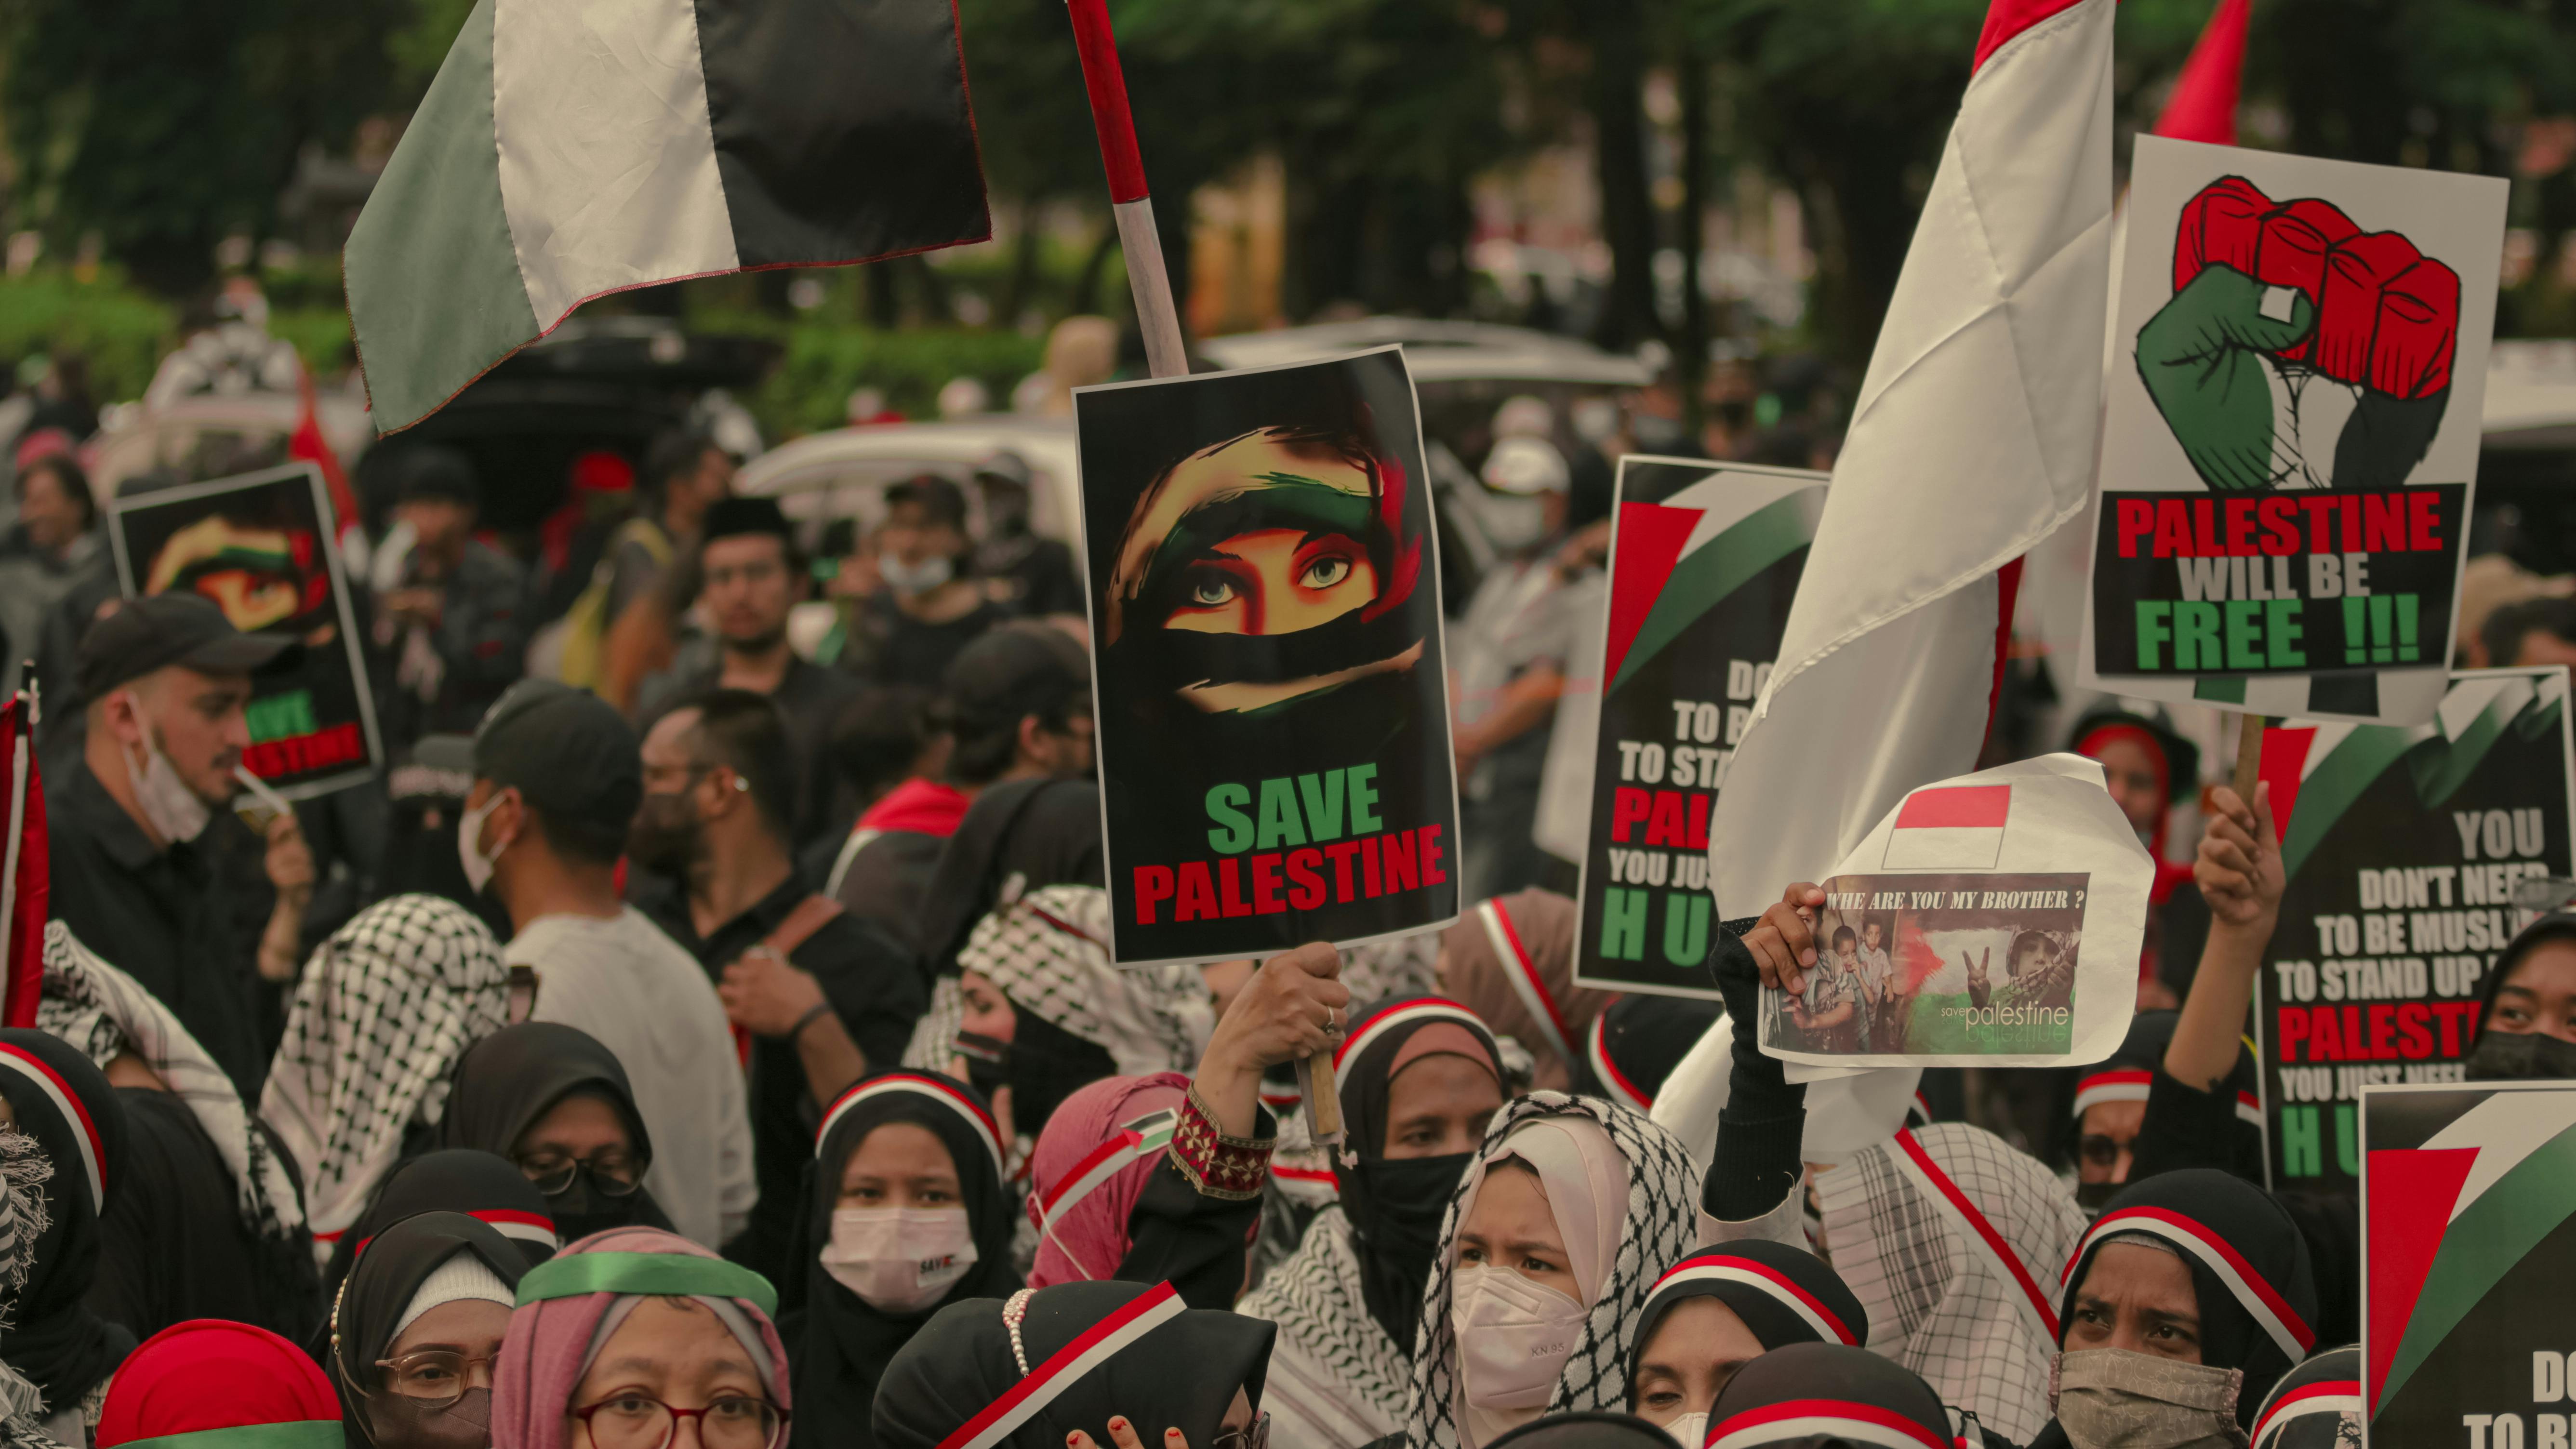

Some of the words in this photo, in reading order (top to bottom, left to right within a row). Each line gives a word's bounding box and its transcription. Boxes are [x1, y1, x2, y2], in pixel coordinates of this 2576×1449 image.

[2117, 491, 2443, 558] PALESTINE
[2177, 555, 2297, 601] WILL
[2308, 552, 2371, 598] BE
[2135, 599, 2306, 669] FREE
[2342, 594, 2419, 664] !!!
[1672, 700, 1720, 744] TO
[1617, 740, 1666, 784] TO
[1205, 762, 1383, 854] SAVE
[2453, 808, 2544, 859] YOU
[1133, 823, 1447, 925] PALESTINE
[1607, 847, 1669, 887] YOU
[2359, 866, 2456, 909] DON'T
[1826, 892, 1866, 910] WHE
[1868, 891, 1906, 910] ARE
[1911, 891, 1947, 910] YOU
[1949, 891, 1978, 910] MY
[1979, 890, 2069, 910] BROTHER
[2314, 914, 2360, 956] TO
[2363, 913, 2407, 955] BE
[2275, 960, 2317, 1002] TO
[2321, 958, 2429, 1001] STAND
[2432, 956, 2482, 997] UP
[1941, 1007, 1965, 1017] save
[1965, 1001, 2069, 1031] palestine
[2279, 1066, 2333, 1102] YOU
[2463, 1413, 2524, 1449] TO
